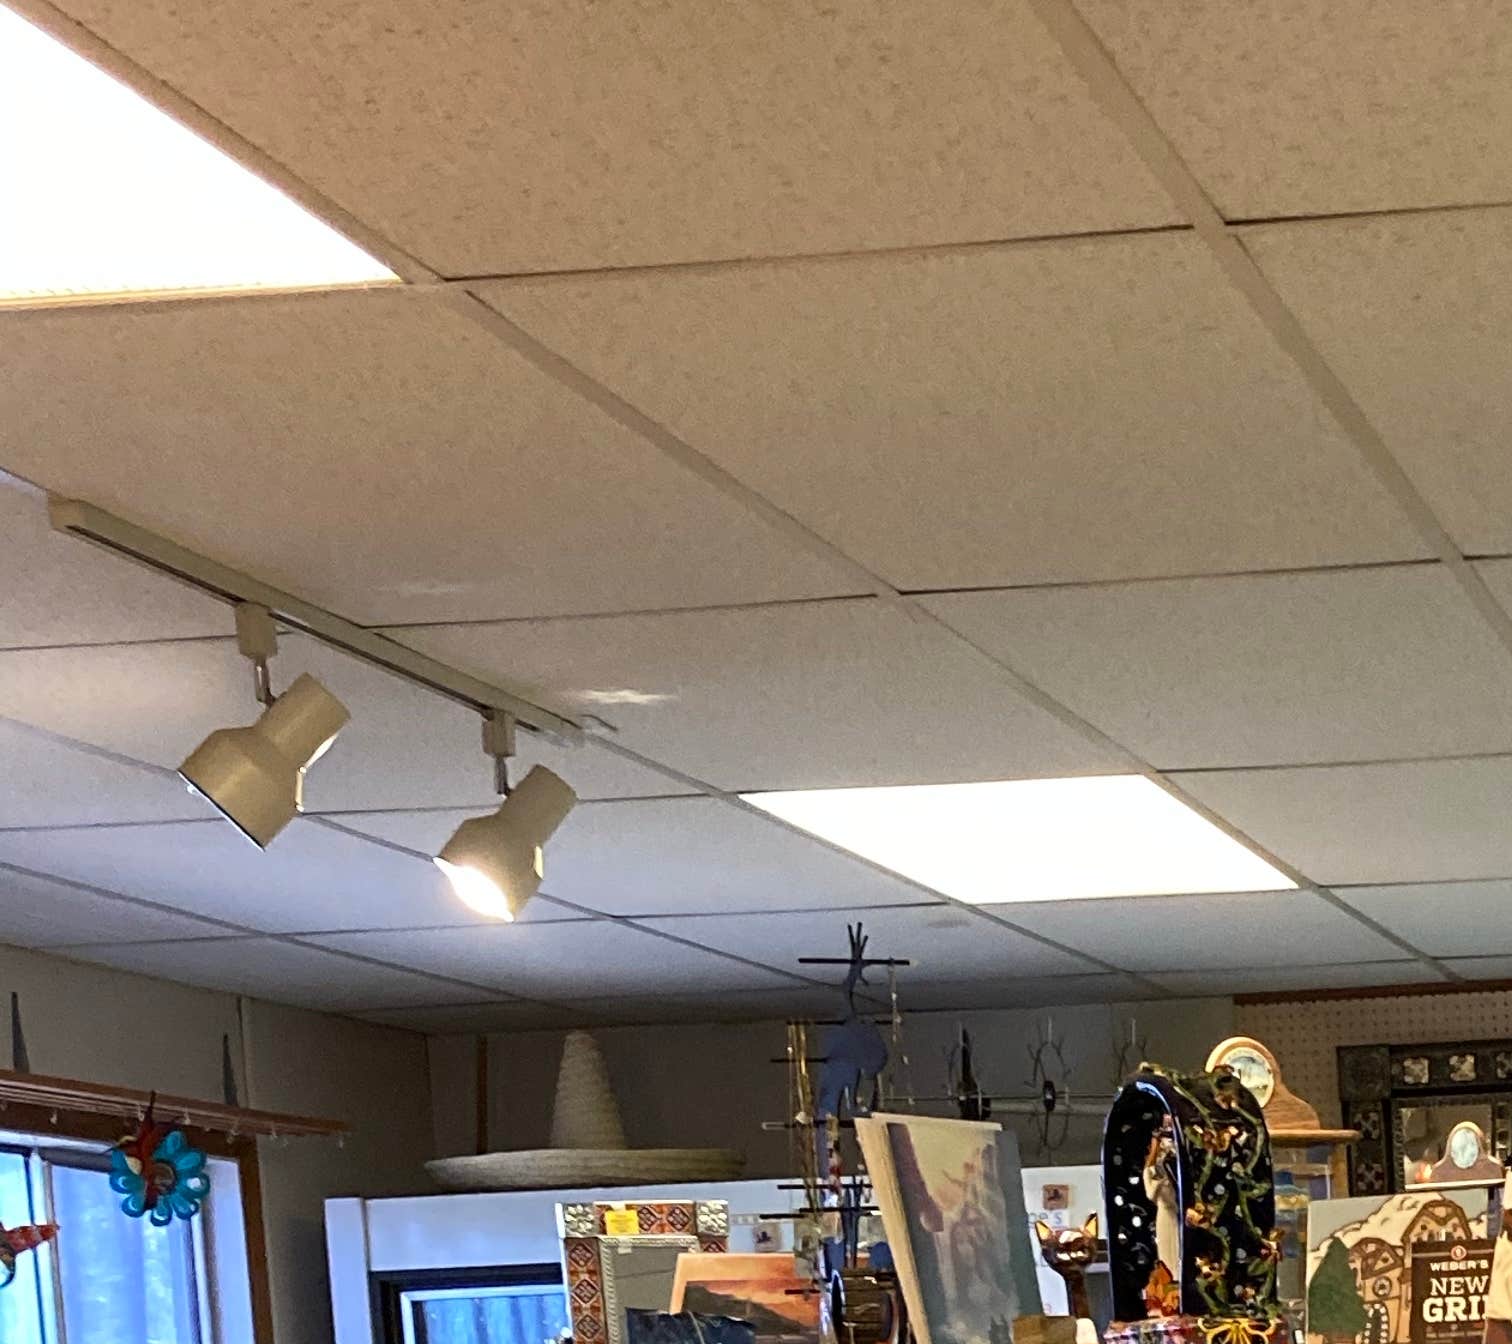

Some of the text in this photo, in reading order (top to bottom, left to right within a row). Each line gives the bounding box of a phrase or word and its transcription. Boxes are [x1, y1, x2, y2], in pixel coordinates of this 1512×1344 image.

[1430, 1259, 1489, 1272] WEBER'S
[1430, 1275, 1489, 1297] NEW
[1422, 1295, 1489, 1323] GRI
